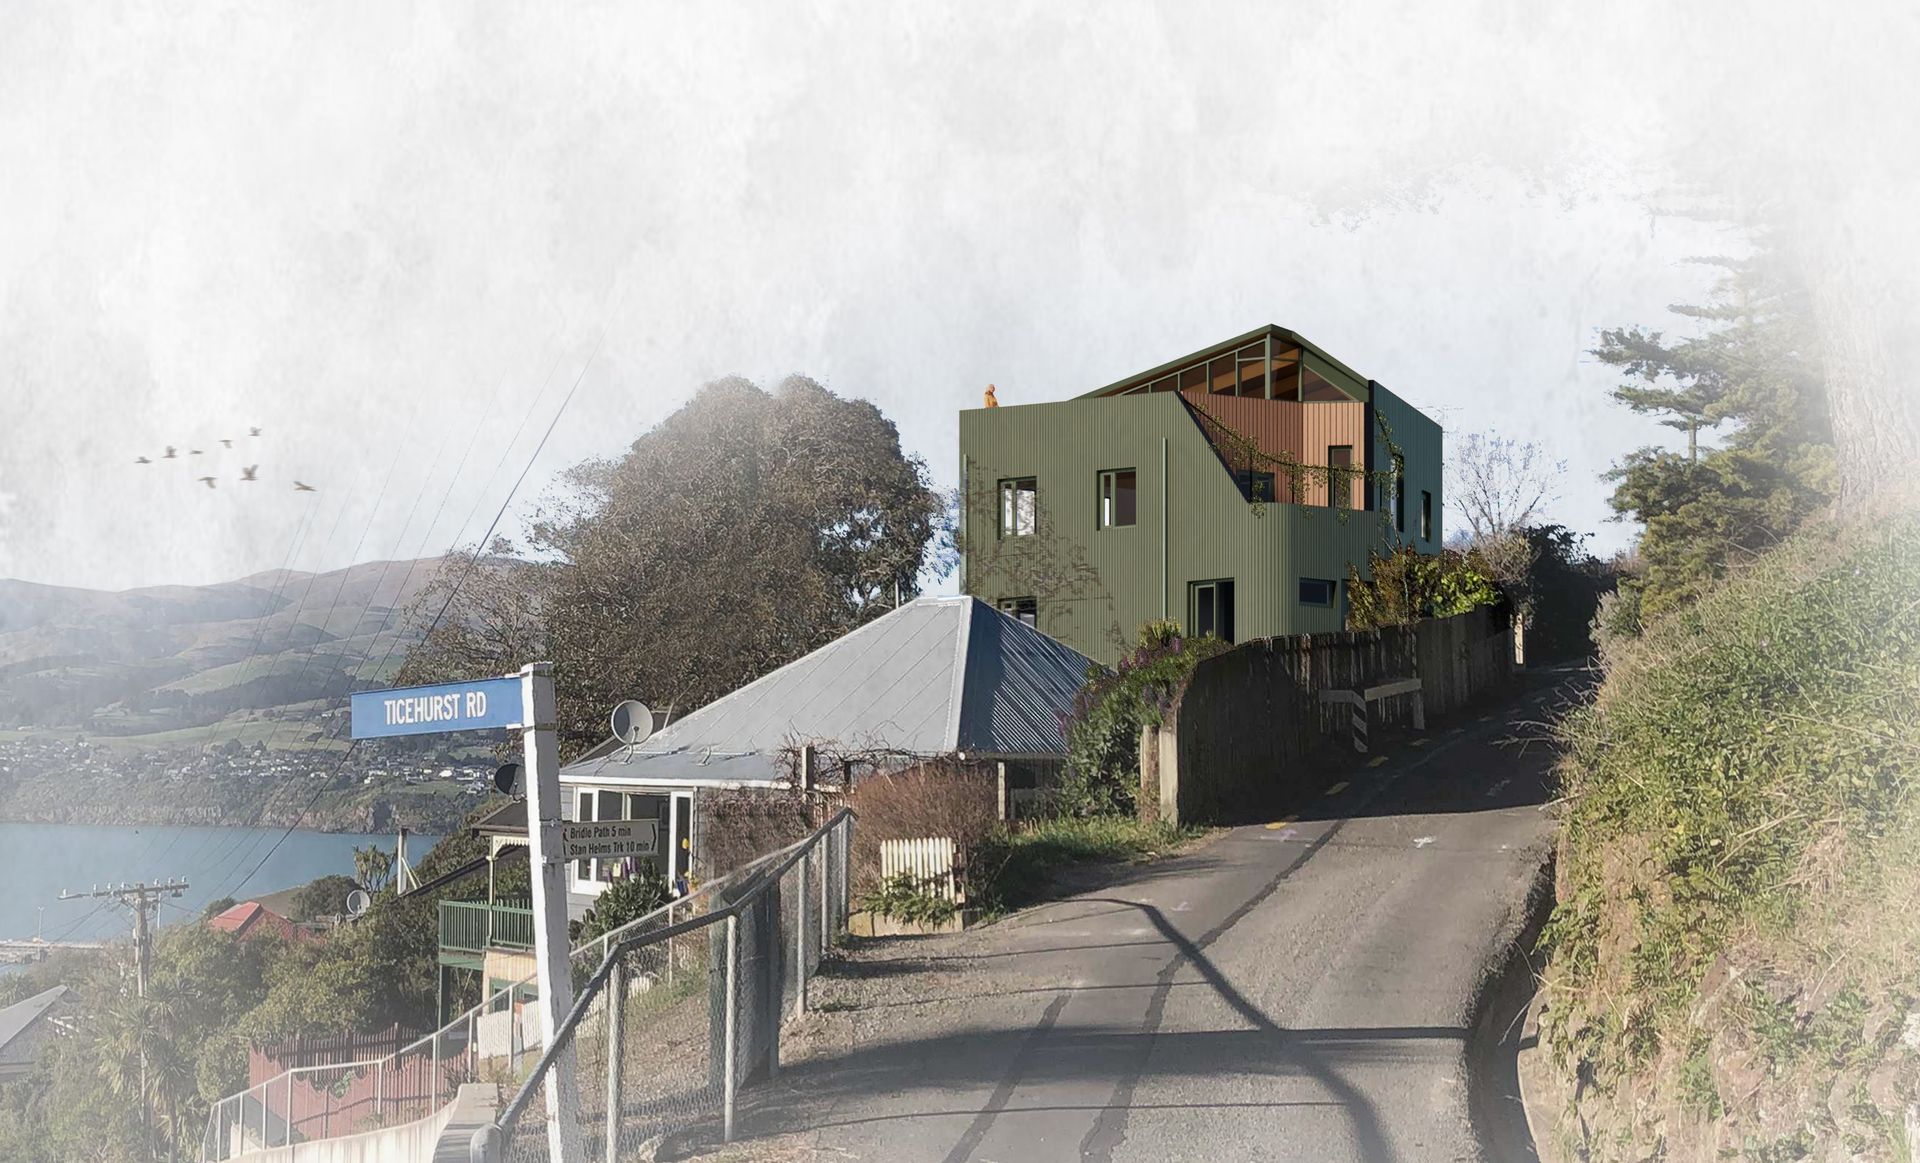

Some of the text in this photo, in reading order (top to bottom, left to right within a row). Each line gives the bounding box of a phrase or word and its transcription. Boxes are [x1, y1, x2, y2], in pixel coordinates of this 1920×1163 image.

[384, 691, 487, 725] TICEHURST RD
[570, 826, 632, 839] Bridle Path 5 min
[570, 840, 650, 856] Stan Helms Trk 10 min
